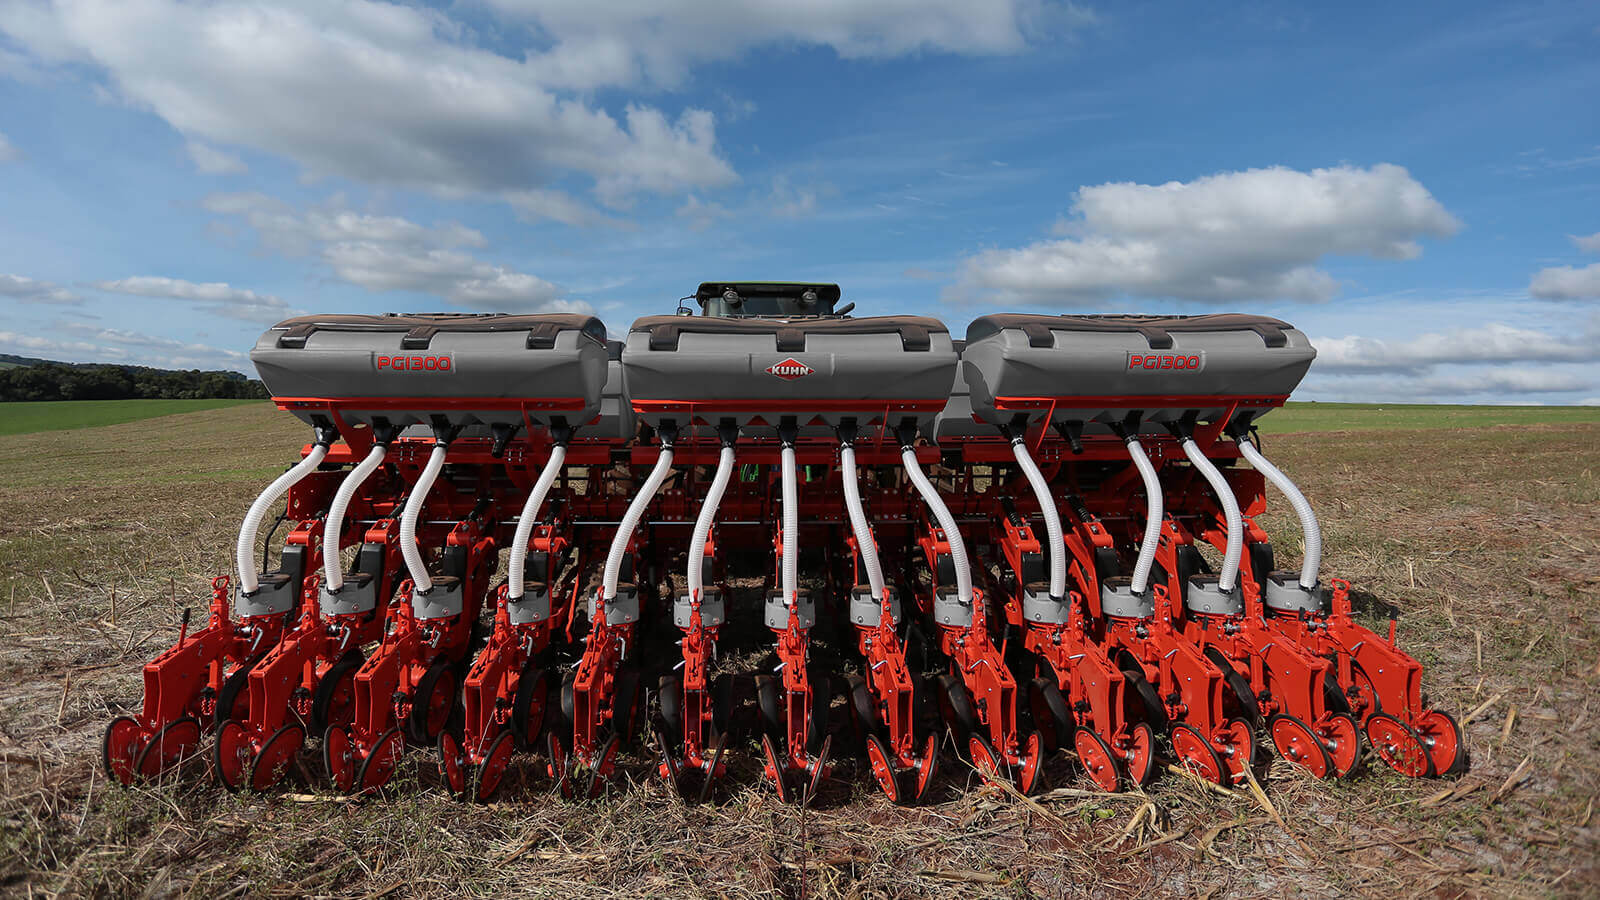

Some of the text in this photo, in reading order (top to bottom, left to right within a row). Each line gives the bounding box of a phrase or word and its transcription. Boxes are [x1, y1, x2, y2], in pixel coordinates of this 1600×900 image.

[377, 356, 451, 370] PG1300
[1129, 355, 1200, 369] PG1300
[771, 366, 809, 375] KUHN
